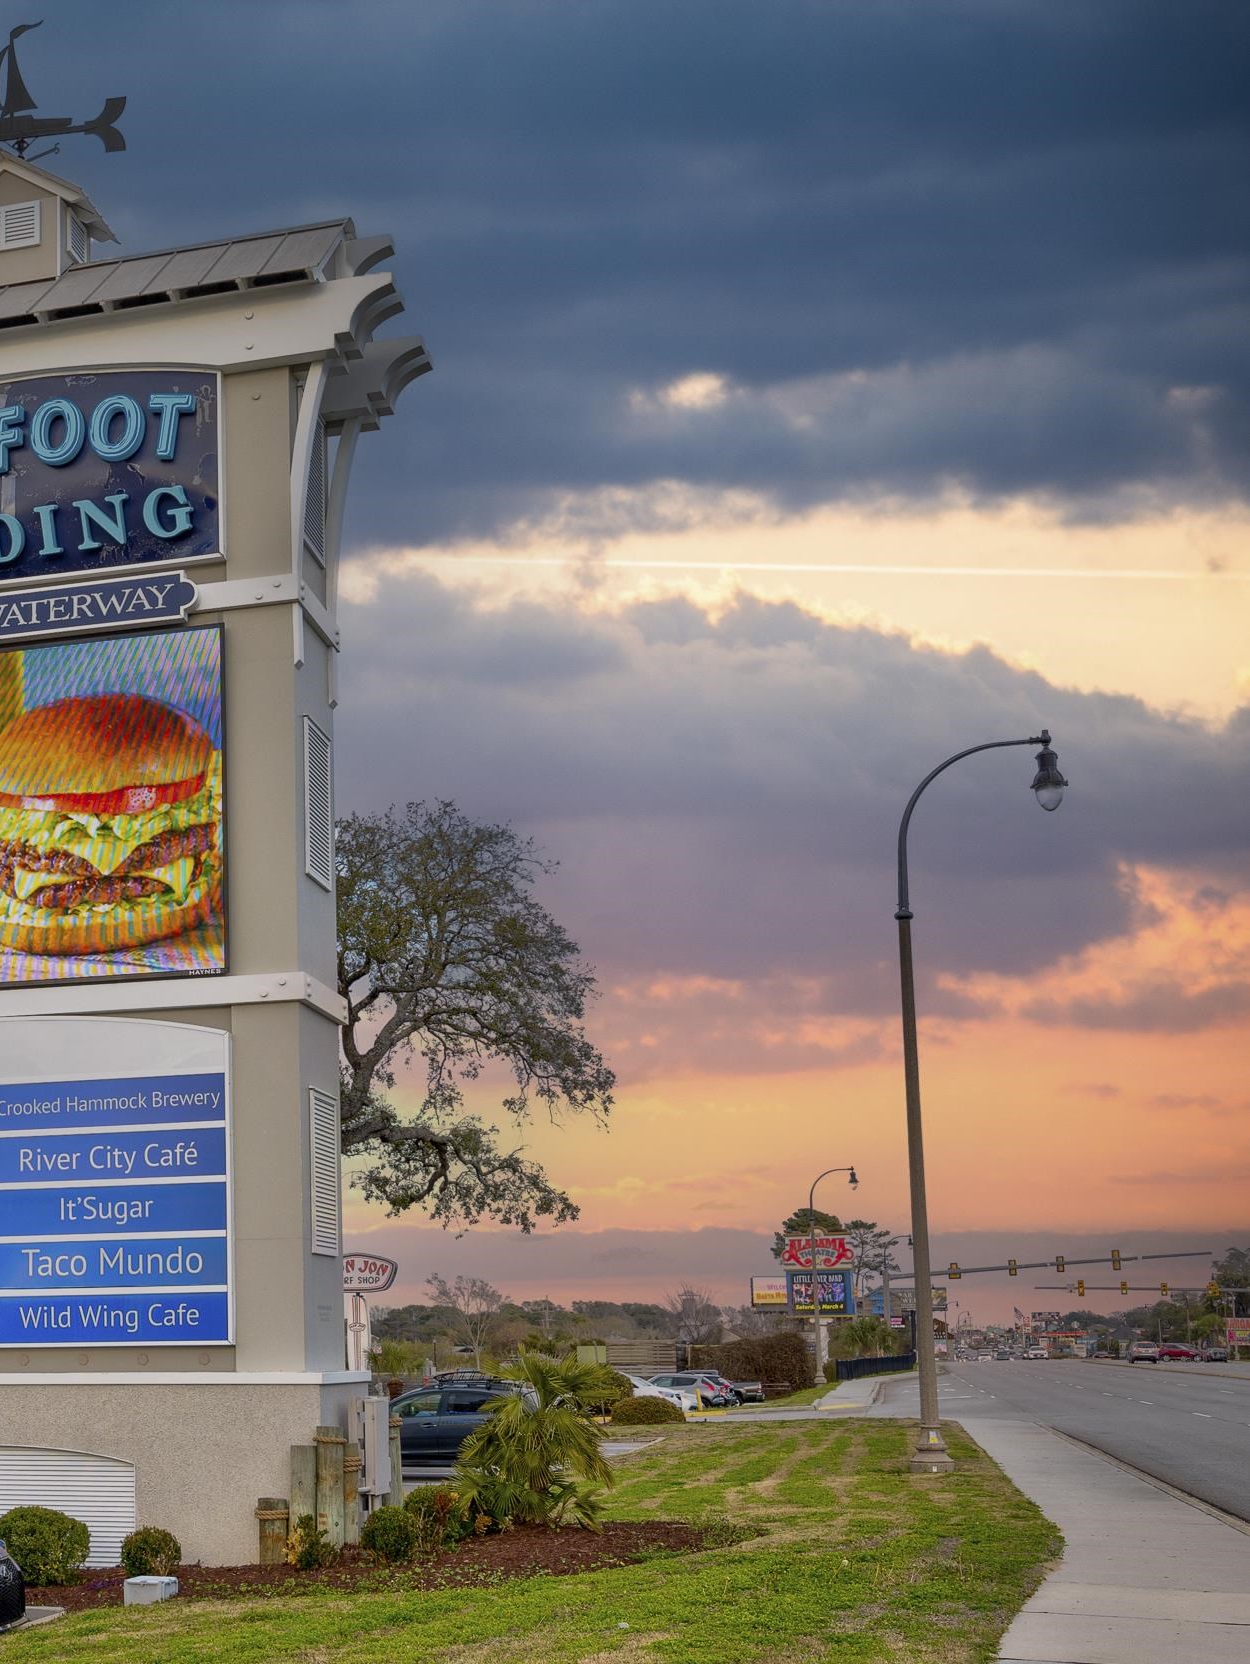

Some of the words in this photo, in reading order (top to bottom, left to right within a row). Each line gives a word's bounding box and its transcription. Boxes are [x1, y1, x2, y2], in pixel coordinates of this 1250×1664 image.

[189, 968, 221, 976] HAYNES
[66, 1092, 147, 1113] Hammock
[152, 1090, 221, 1109] Brewery
[19, 1148, 81, 1172] River
[89, 1145, 137, 1174] City
[144, 1141, 198, 1167] Café
[60, 1196, 154, 1225] It'Sugar
[21, 1248, 87, 1277] Taco
[99, 1245, 203, 1275] Mundo
[799, 1248, 836, 1258] THATRE
[358, 1260, 389, 1276] JON
[357, 1276, 381, 1285] SHOP
[19, 1305, 71, 1329] Wild
[78, 1304, 138, 1333] Wing
[148, 1303, 200, 1326] Cafe
